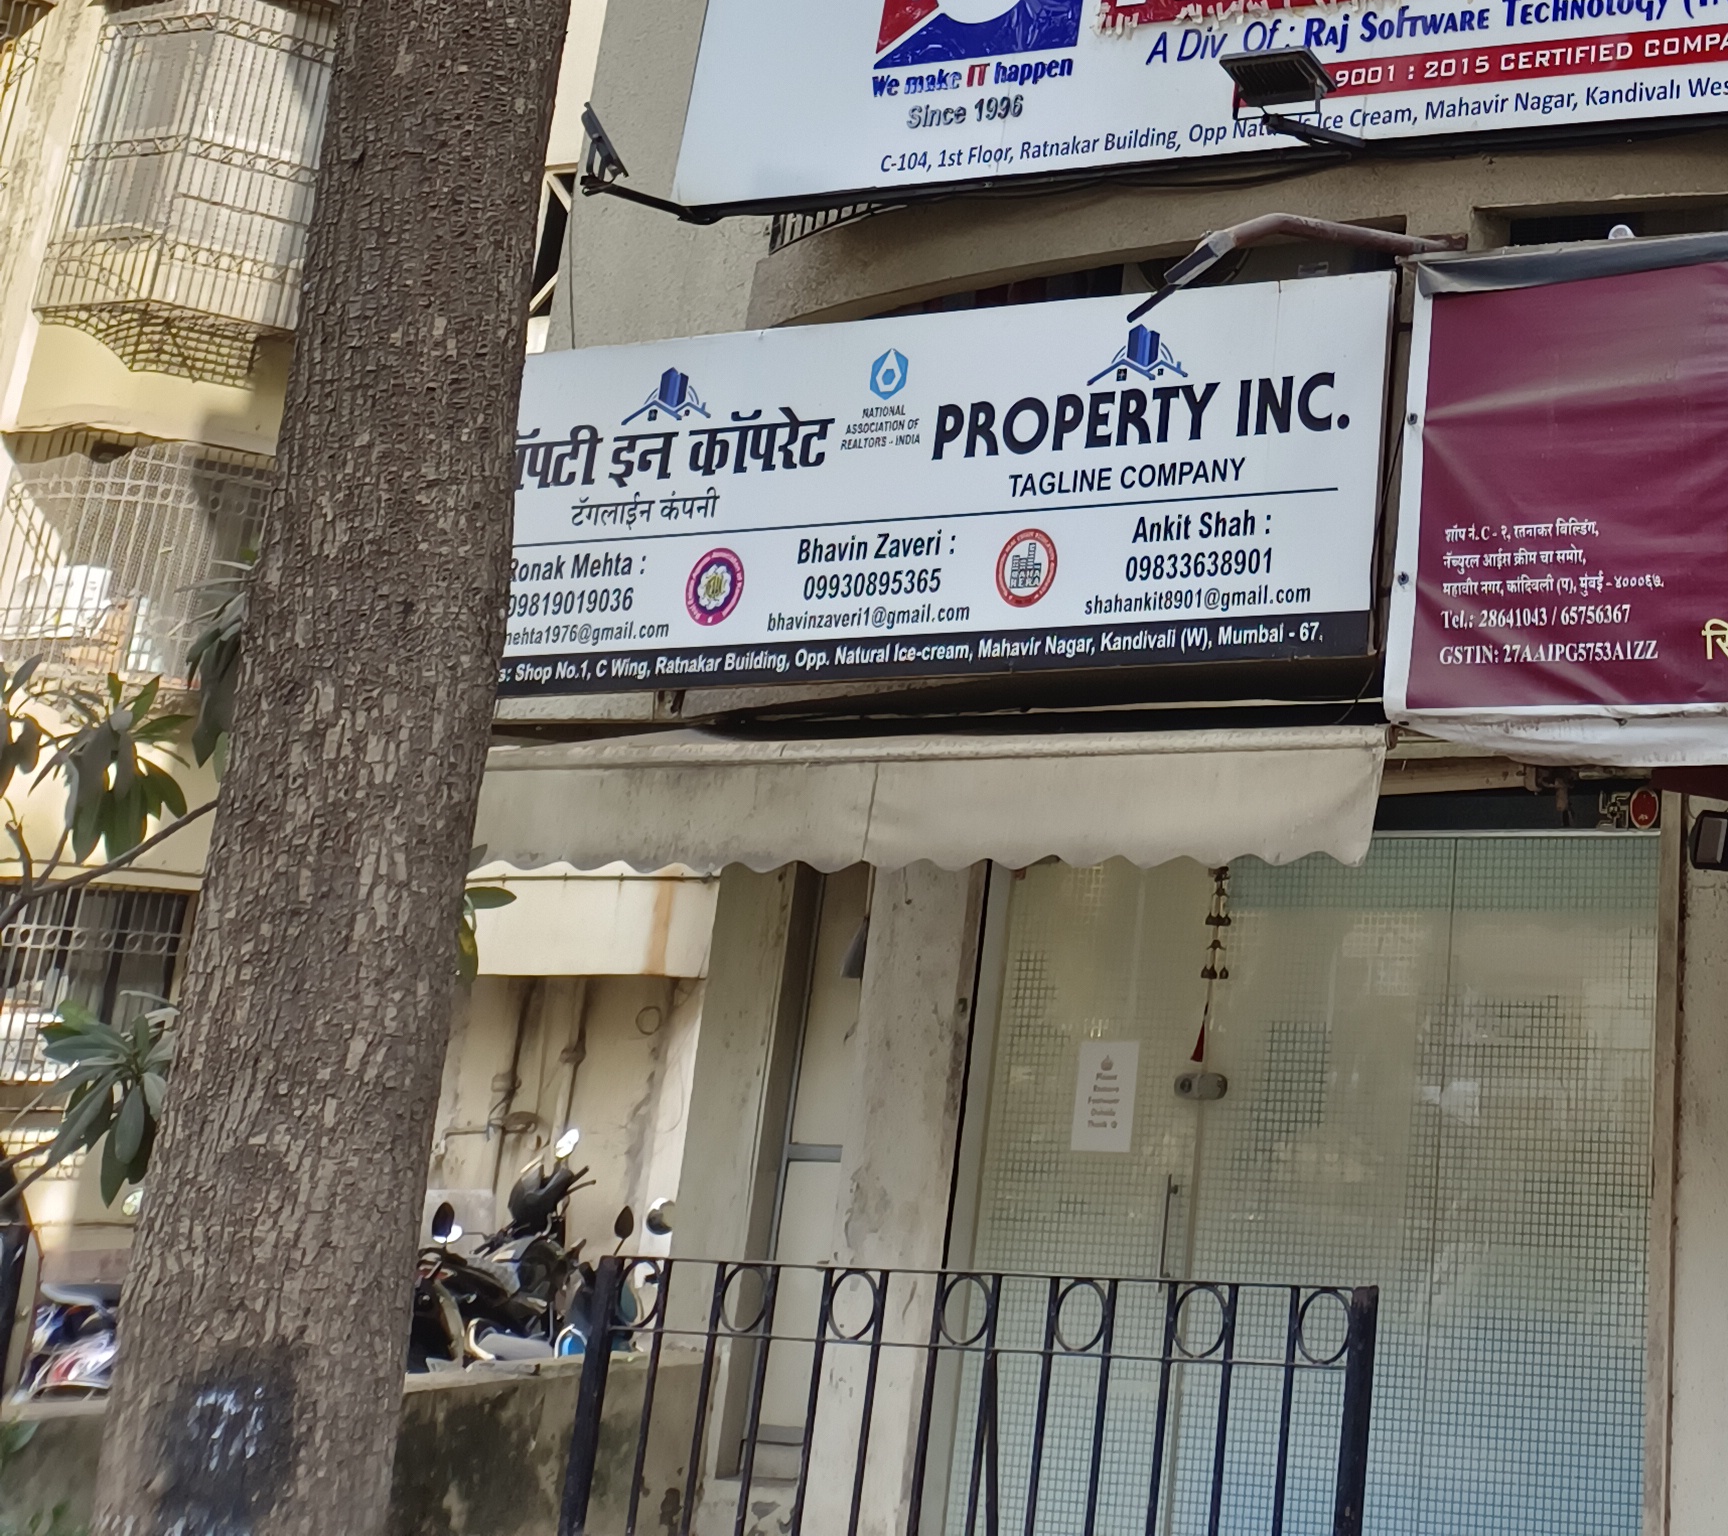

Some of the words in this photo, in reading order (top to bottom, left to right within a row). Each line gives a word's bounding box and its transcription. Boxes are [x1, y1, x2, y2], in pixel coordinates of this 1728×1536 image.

[1177, 26, 1227, 62] Div
[871, 74, 900, 98] We
[903, 69, 962, 95] make
[966, 63, 990, 88] IT
[993, 57, 1074, 87] happen
[1335, 64, 1396, 88] 9001
[1424, 54, 1491, 81] 2015
[1499, 40, 1634, 73] CERTIFIED
[880, 149, 933, 175] C-104,
[936, 146, 965, 169] 1st
[967, 142, 1015, 165] Floor,
[1019, 134, 1101, 161] Ratnakar
[1103, 127, 1181, 153] Building,
[1188, 122, 1227, 145] Opp
[1350, 107, 1418, 128] Cream,
[1425, 94, 1510, 121] Mahavir
[1514, 90, 1580, 115] Nagar,
[1585, 80, 1681, 108] Kandivali
[906, 104, 967, 129] Since
[973, 94, 1024, 123] 1996
[861, 404, 906, 419] NATIONAL
[931, 380, 1221, 462] PROPERTY
[1235, 371, 1351, 438] INC.
[894, 433, 921, 446] INDIA
[608, 430, 679, 489] इन
[1008, 466, 1113, 498] TAGLINE
[1119, 456, 1247, 490] COMPANY
[660, 486, 721, 520] कंपनी
[1132, 512, 1191, 544] Ankit
[1198, 509, 1257, 540] Shah
[797, 536, 868, 566] Bhavin
[873, 529, 943, 561] Zaveri
[1125, 547, 1274, 583] 09833638901
[510, 554, 566, 583] Ronak
[570, 551, 634, 580] Mehta
[803, 567, 942, 602] 09930895365
[766, 602, 971, 633] bhavinzaveri1@gmail.com
[1084, 584, 1312, 618] shahankit8901@gmail.com
[1478, 607, 1548, 629] 28641043
[1560, 603, 1632, 626] 65756367
[514, 663, 553, 685] Shop
[611, 656, 651, 680] Wing,
[655, 648, 723, 675] Ratnakar
[724, 647, 791, 674] Building,
[794, 647, 831, 670] Opp.
[834, 644, 891, 666] Natural
[893, 641, 974, 663] Ice-cream,
[978, 636, 1041, 662] Mahavir
[1044, 633, 1097, 659] Nagar,
[1100, 629, 1176, 653] Kandivali
[1180, 627, 1213, 651] (W),
[1217, 622, 1285, 646] Mumbai
[1439, 644, 1500, 665] GSTIN:
